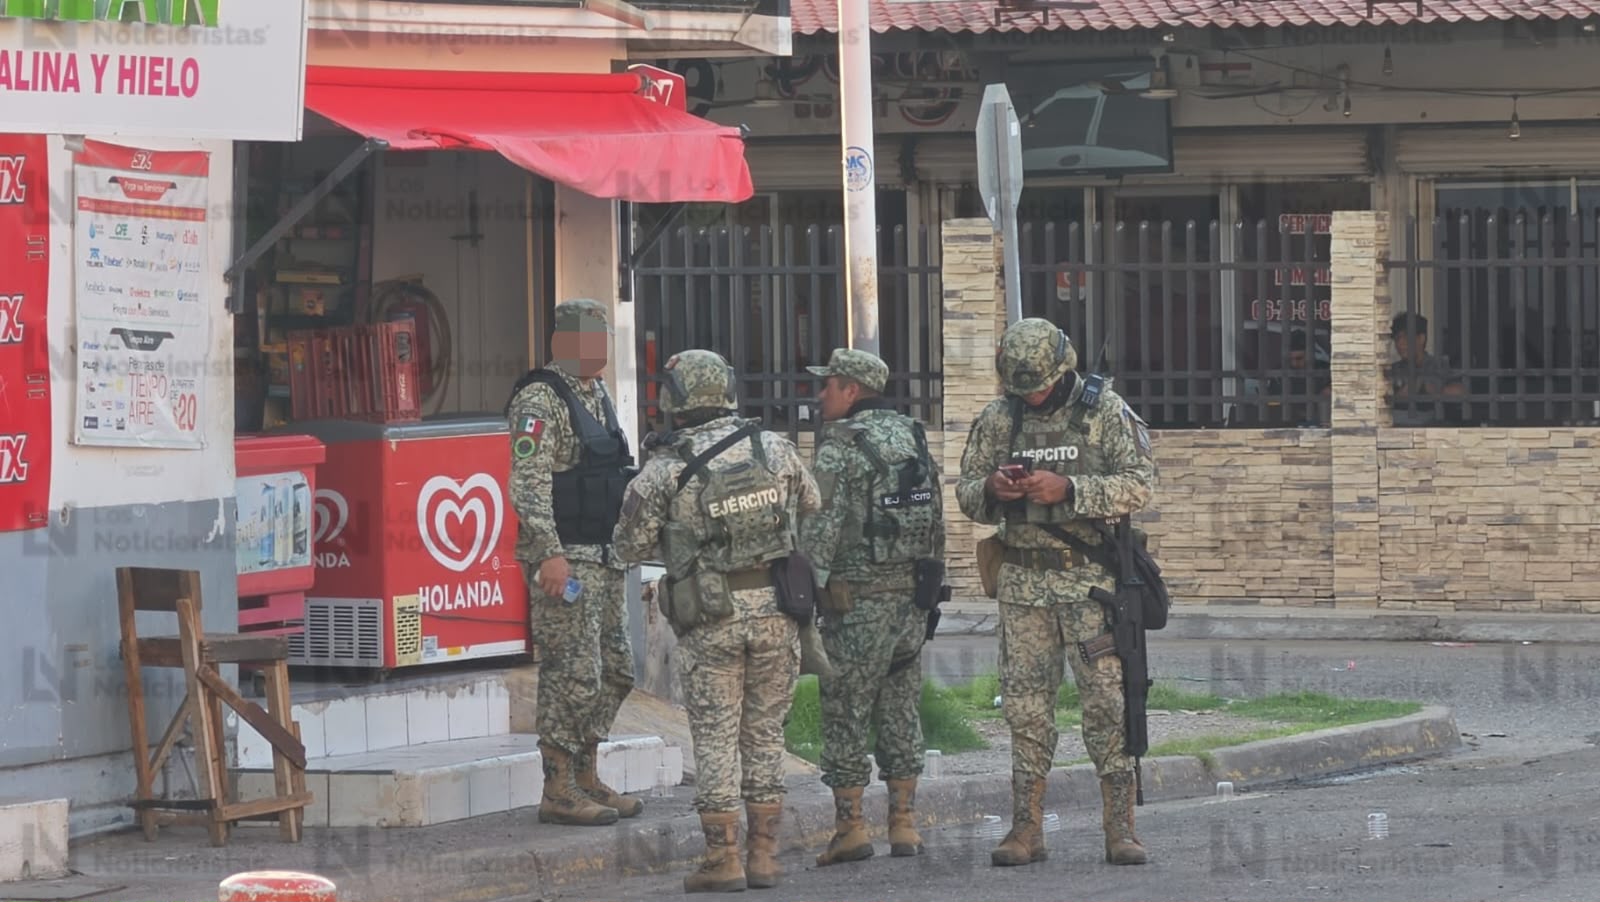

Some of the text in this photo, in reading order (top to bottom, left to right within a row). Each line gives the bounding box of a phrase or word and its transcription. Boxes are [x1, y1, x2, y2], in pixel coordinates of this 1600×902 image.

[90, 53, 110, 94] Y
[117, 55, 200, 98] HIELO
[708, 487, 779, 519] EJÉRCITO
[419, 580, 504, 613] HOLANDA
